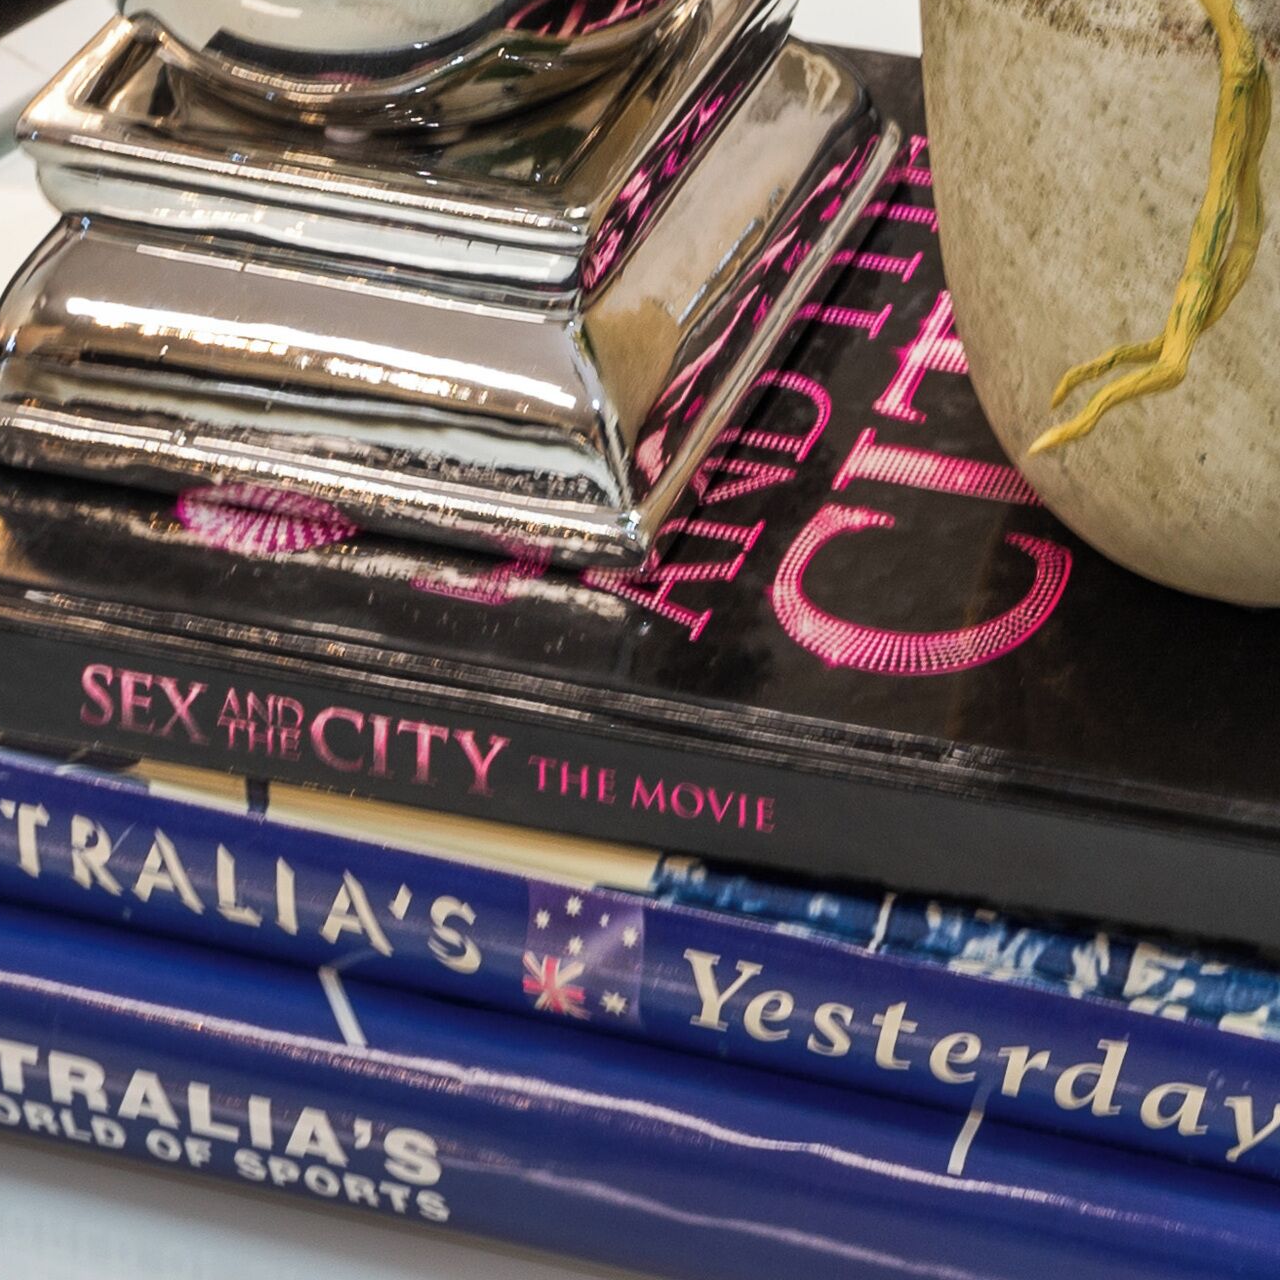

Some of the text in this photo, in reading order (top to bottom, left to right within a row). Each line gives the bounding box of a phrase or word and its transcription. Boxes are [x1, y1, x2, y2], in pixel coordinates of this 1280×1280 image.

[79, 663, 776, 834] SEX AND THE CITY THE MOVIE
[146, 1130, 210, 1165] OF
[234, 1150, 449, 1220] SPORTS
